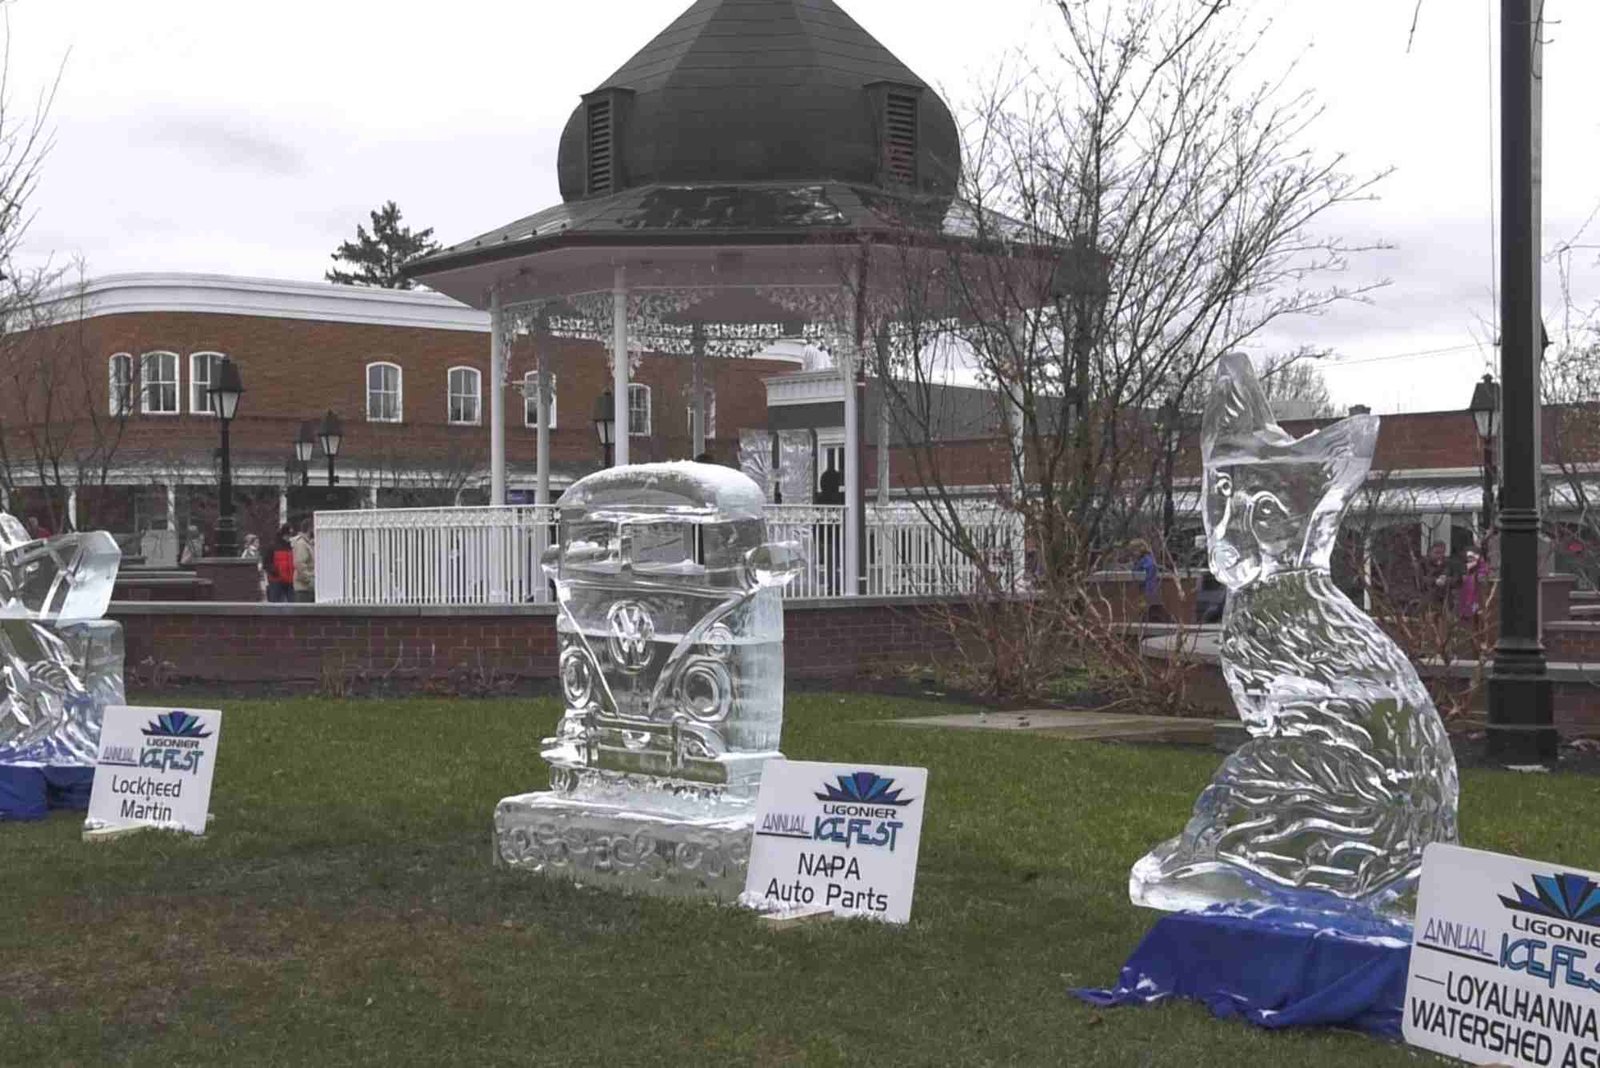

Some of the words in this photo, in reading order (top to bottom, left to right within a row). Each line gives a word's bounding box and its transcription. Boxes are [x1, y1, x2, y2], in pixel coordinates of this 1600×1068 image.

[103, 746, 137, 763] ANNUAL
[112, 774, 182, 798] Lockheed
[120, 799, 172, 821] Martin
[823, 804, 897, 819] LIGONIER
[762, 812, 809, 835] ANNUAL
[798, 852, 861, 880] NAPA
[765, 877, 814, 904] Auto
[825, 883, 888, 912] Parts
[1423, 917, 1494, 958] ANNUAL
[1446, 970, 1599, 1042] LOYALHANNA
[1412, 996, 1553, 1067] WATERSHED
[1561, 1041, 1600, 1068] AS
